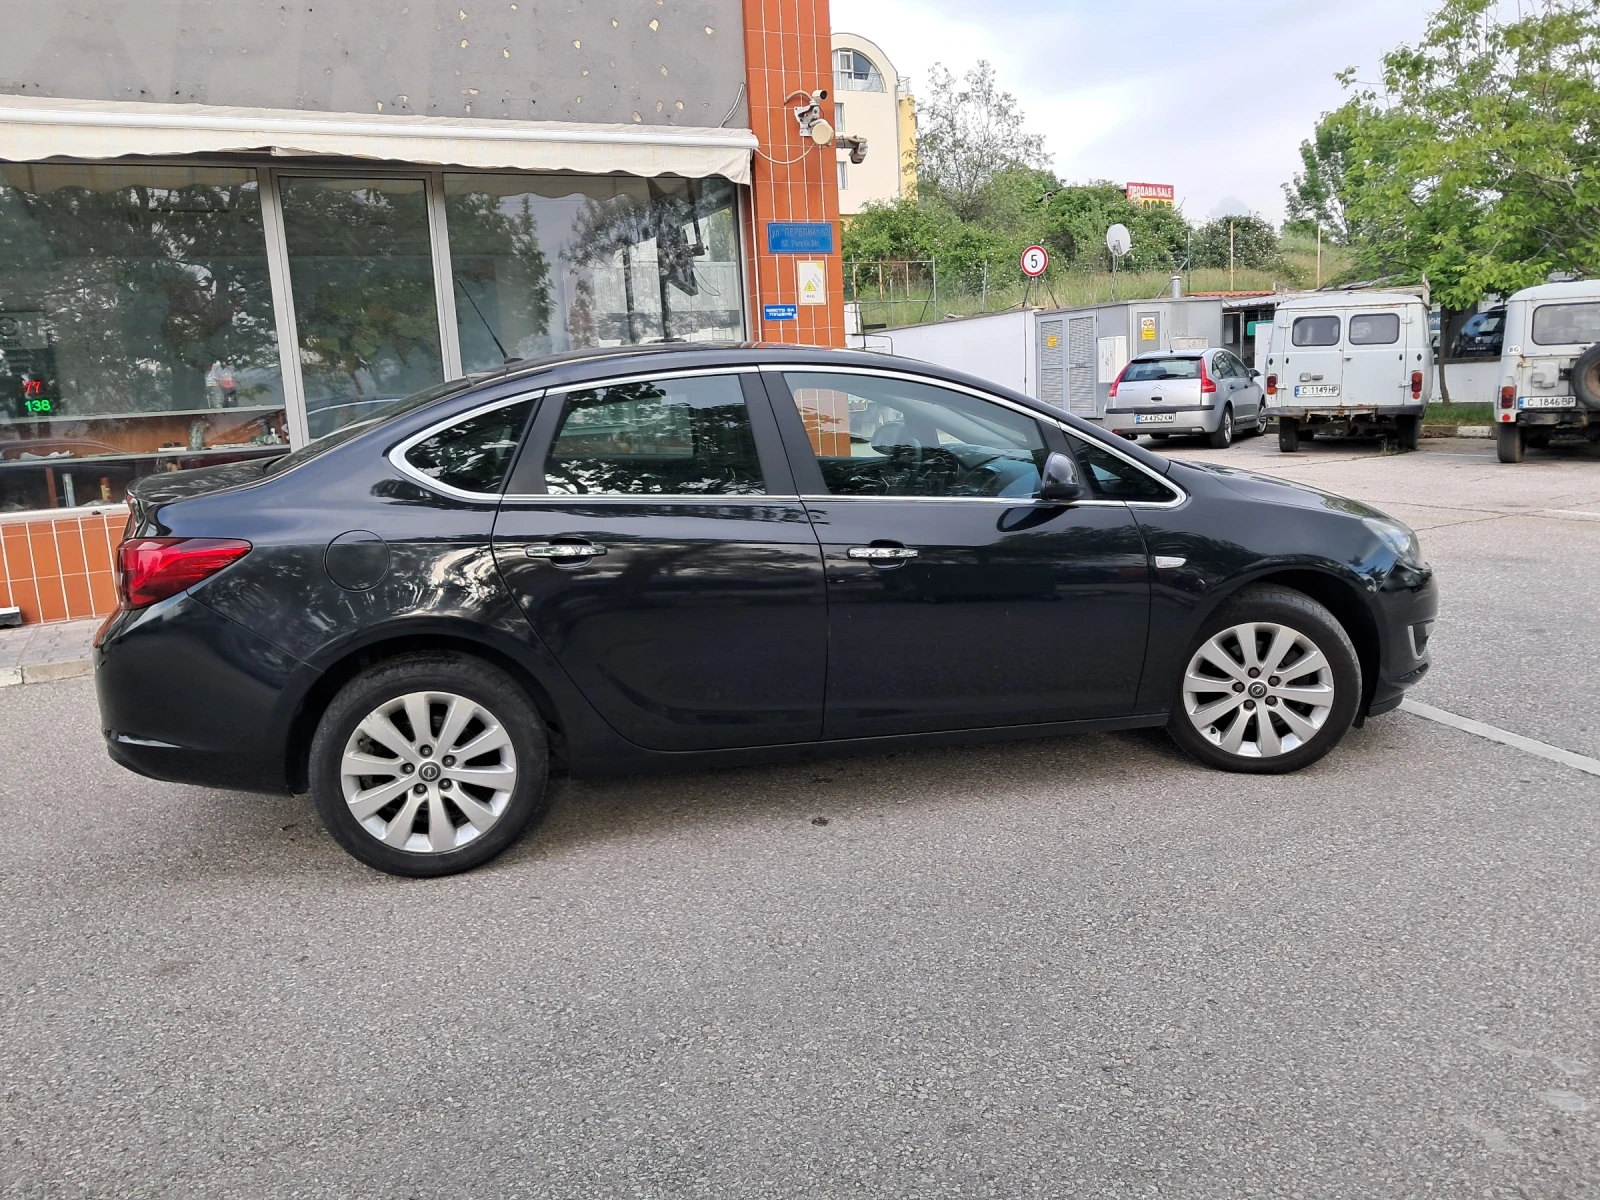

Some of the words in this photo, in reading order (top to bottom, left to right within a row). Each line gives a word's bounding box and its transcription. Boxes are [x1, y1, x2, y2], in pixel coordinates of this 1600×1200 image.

[1031, 254, 1038, 268] 5
[25, 382, 41, 394] 77
[25, 399, 51, 412] 138
